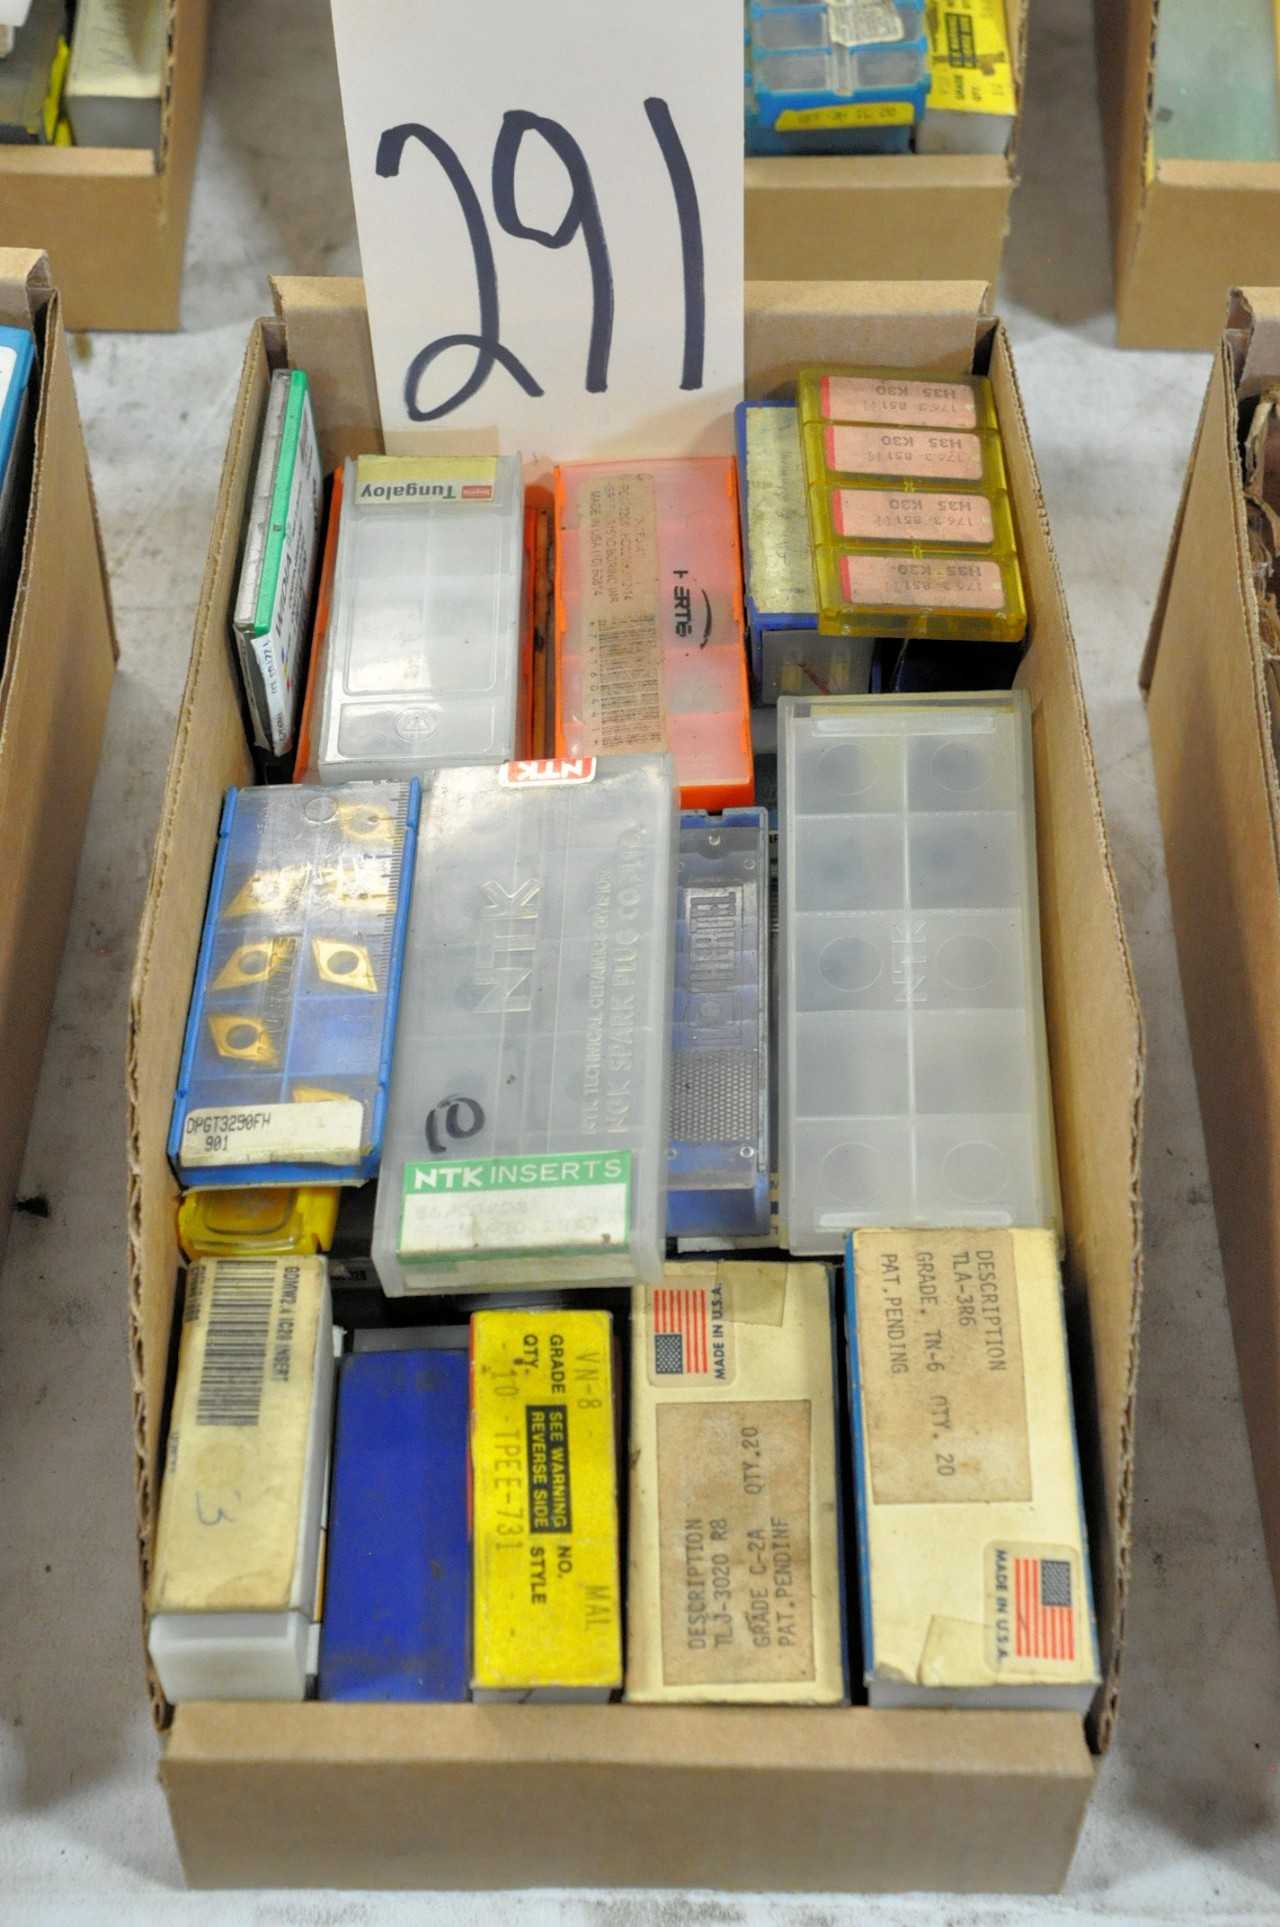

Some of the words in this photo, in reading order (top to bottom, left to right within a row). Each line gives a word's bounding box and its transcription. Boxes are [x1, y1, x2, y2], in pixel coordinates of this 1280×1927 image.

[375, 97, 704, 421] 291
[875, 384, 908, 397] K30
[922, 387, 955, 399] H35
[880, 435, 914, 447] K30
[928, 437, 962, 449] H35
[361, 482, 456, 500] Tungaloy
[889, 498, 922, 511] K30
[938, 500, 971, 511] H35
[516, 759, 583, 780] NTK
[414, 1167, 484, 1190] NTK
[490, 1159, 622, 1184] INSERTS
[952, 1252, 976, 1327] TLA-3R6
[881, 1254, 909, 1375] PAT.PENDING
[976, 1250, 1006, 1372] DESCRIPTION
[712, 1325, 723, 1338] IN
[271, 1344, 292, 1382] INSERT
[522, 1334, 539, 1376] QTY.
[550, 1334, 566, 1394] GRADE
[713, 1342, 726, 1380] MADE
[573, 1351, 602, 1409] VN-8
[923, 1329, 944, 1373] TN-6
[935, 1453, 956, 1477] 20
[549, 1411, 563, 1442] SEE
[531, 1411, 547, 1484] REVERSE
[550, 1447, 567, 1528] WARNING
[533, 1489, 548, 1528] SIDE
[710, 1518, 728, 1541] R8
[557, 1545, 572, 1579] NO.
[748, 1528, 767, 1575] C-2A
[995, 1549, 1008, 1591] MADE
[530, 1546, 546, 1605] STYLE
[685, 1518, 706, 1649] DESCRIPTION
[712, 1553, 733, 1648] TLJ-3020
[749, 1588, 770, 1648] GRADE
[997, 1597, 1008, 1613] IN
